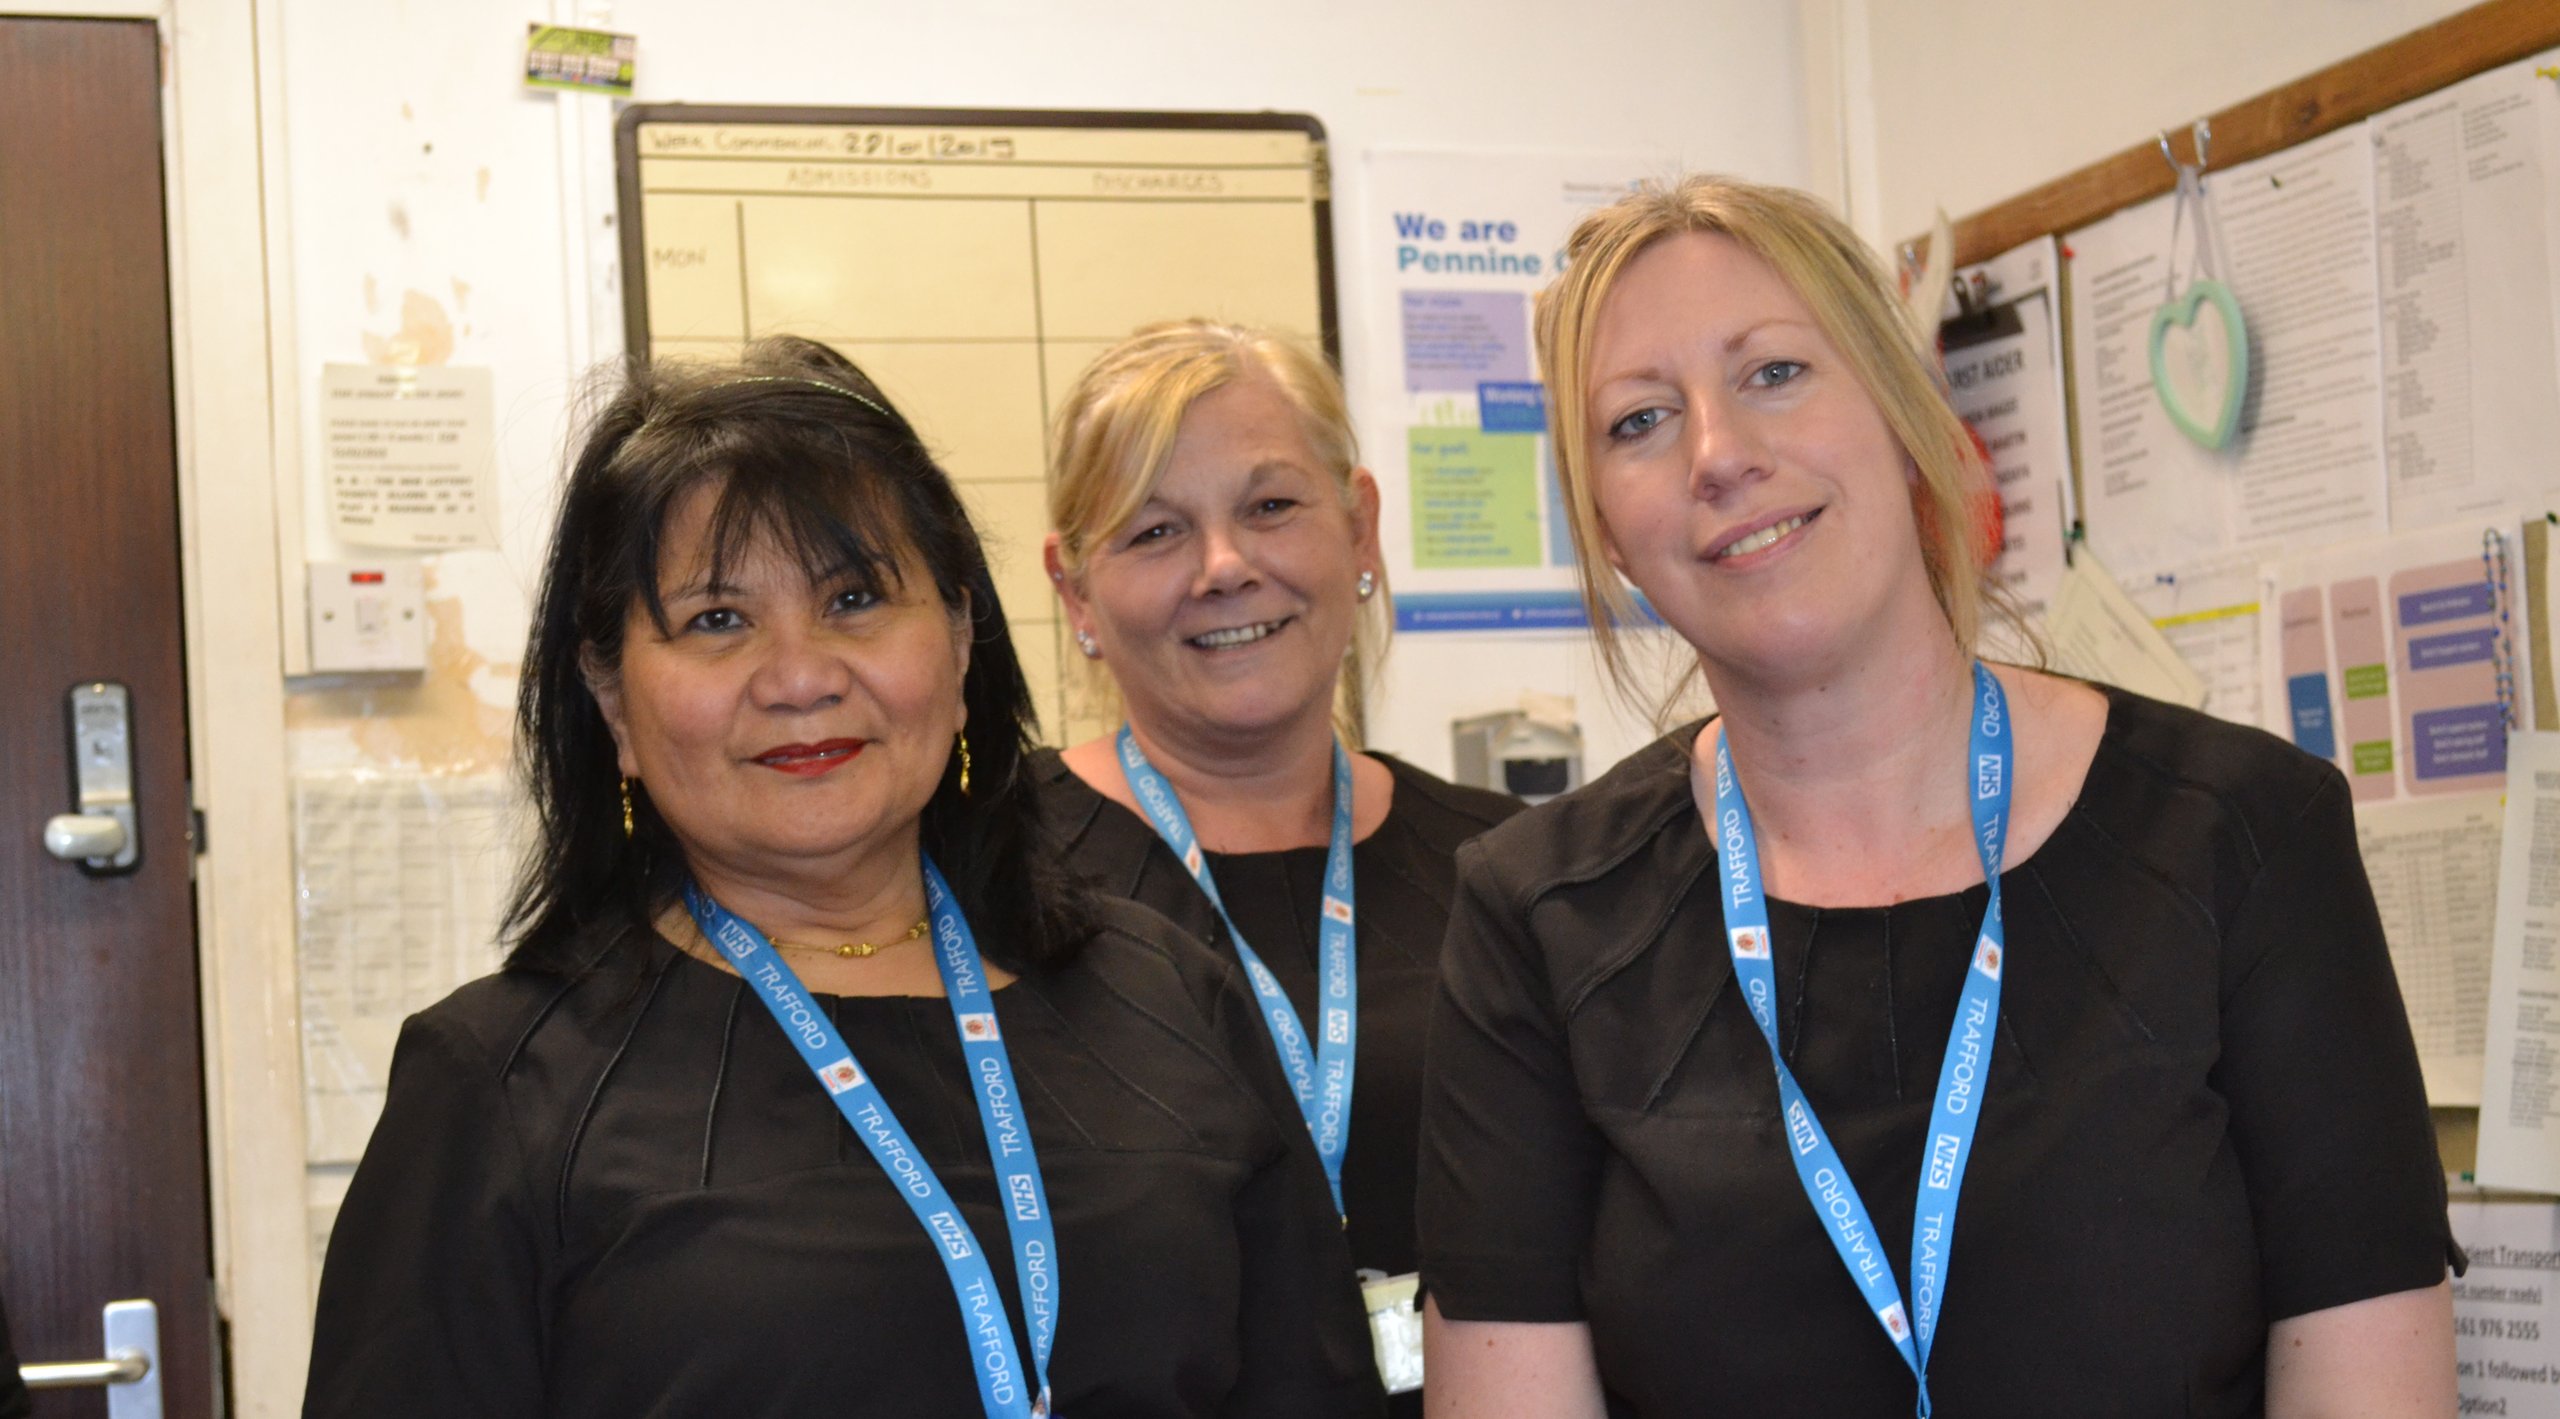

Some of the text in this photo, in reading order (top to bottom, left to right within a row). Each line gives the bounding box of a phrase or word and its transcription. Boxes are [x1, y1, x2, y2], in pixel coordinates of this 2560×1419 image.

[1394, 213, 1518, 242] We are
[1398, 246, 1542, 275] Pennine
[1979, 754, 2001, 799] NHS
[1724, 808, 1753, 909] TRAFFORD
[718, 919, 758, 959] NHS
[938, 914, 979, 998] TRAFFORD
[1328, 932, 1348, 999] TRAFFORD
[755, 962, 828, 1050] TRAFFORD
[1272, 1008, 1314, 1103] TRAFFORD
[1946, 997, 1988, 1115] TRAFFORD
[980, 1056, 1023, 1158] TRAFFORD
[1319, 1059, 1345, 1156] TRAFFORD
[1787, 1099, 1819, 1156] NHS
[857, 1102, 932, 1199] TRAFFORD
[1928, 1133, 1960, 1190] NHS
[928, 1211, 973, 1260] NHS
[1008, 1173, 1041, 1221] NHS
[1814, 1167, 1884, 1287] TRAFFORD
[1025, 1240, 1050, 1360] TRAFFORD
[1920, 1211, 1944, 1340] TRAFFORD
[966, 1277, 1013, 1405] TRAFFORD
[2480, 1318, 2503, 1338] 976
[2507, 1320, 2540, 1340] 2555
[2488, 1359, 2548, 1383] followed
